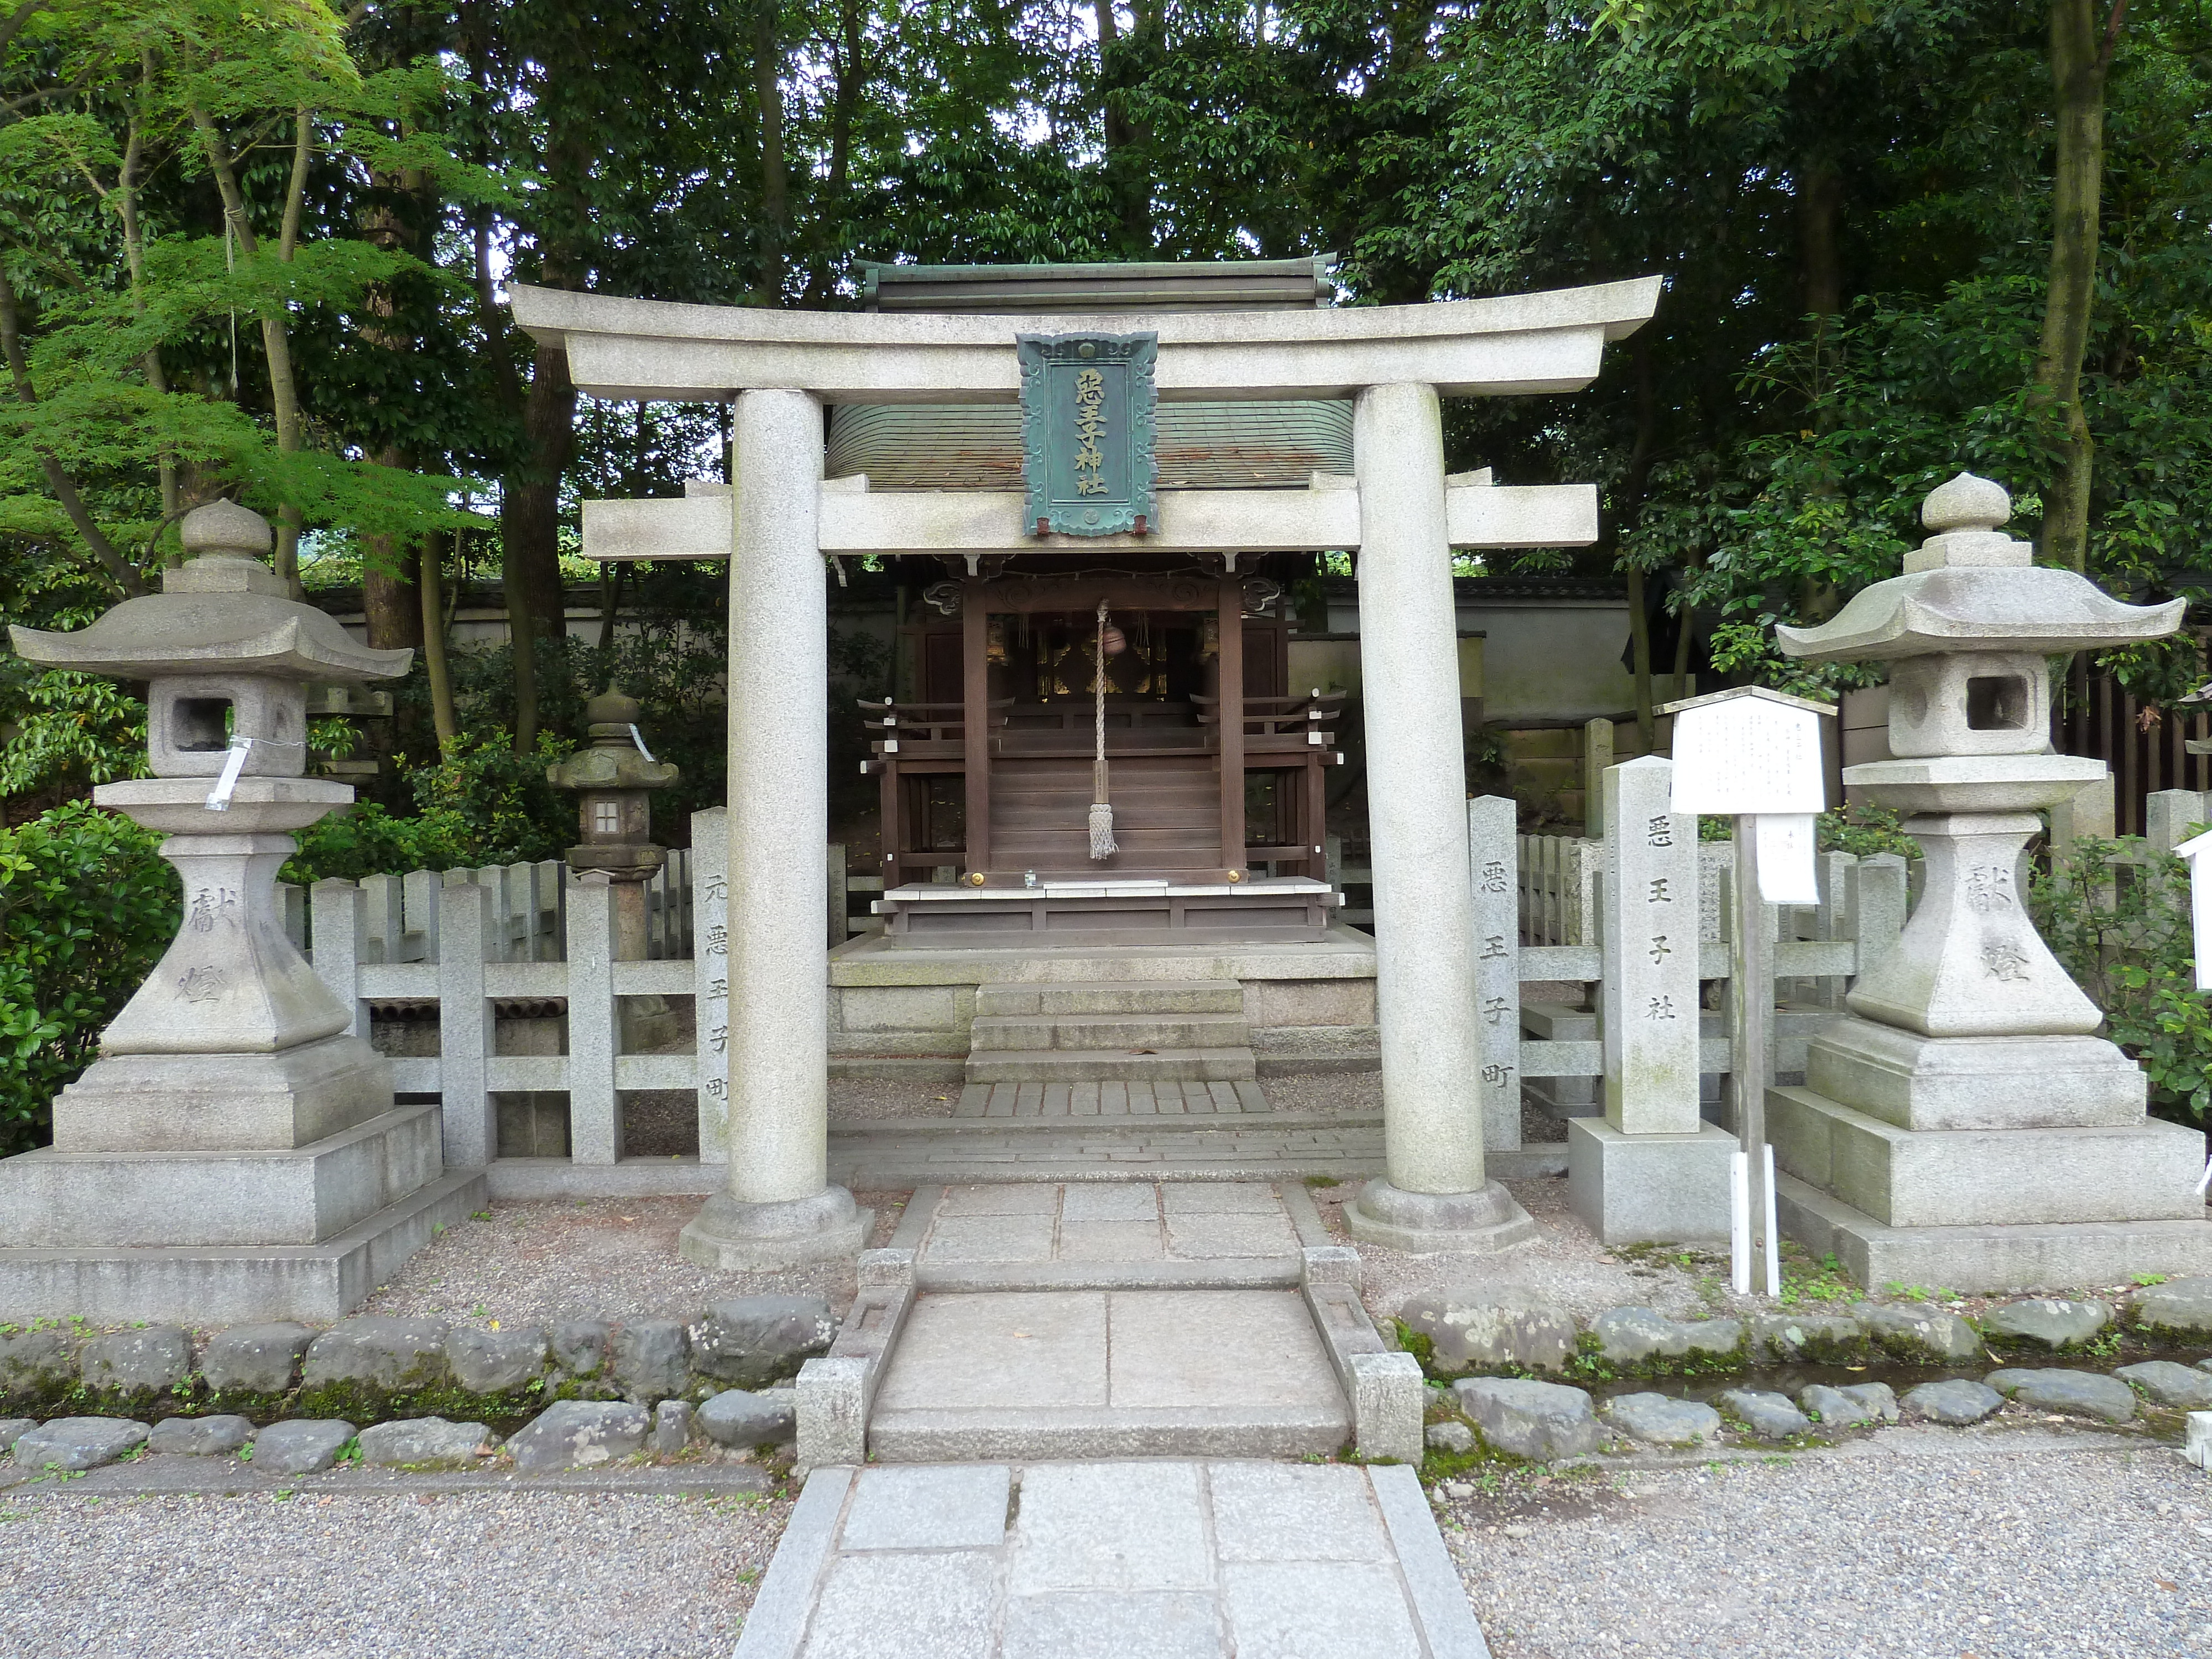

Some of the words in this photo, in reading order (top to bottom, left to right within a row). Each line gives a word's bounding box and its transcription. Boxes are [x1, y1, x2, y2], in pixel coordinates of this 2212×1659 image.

[705, 874, 728, 1100] 元悪王子町
[1480, 860, 1514, 1088] 悪王子町
[1645, 815, 1676, 1020] 悪王子社
